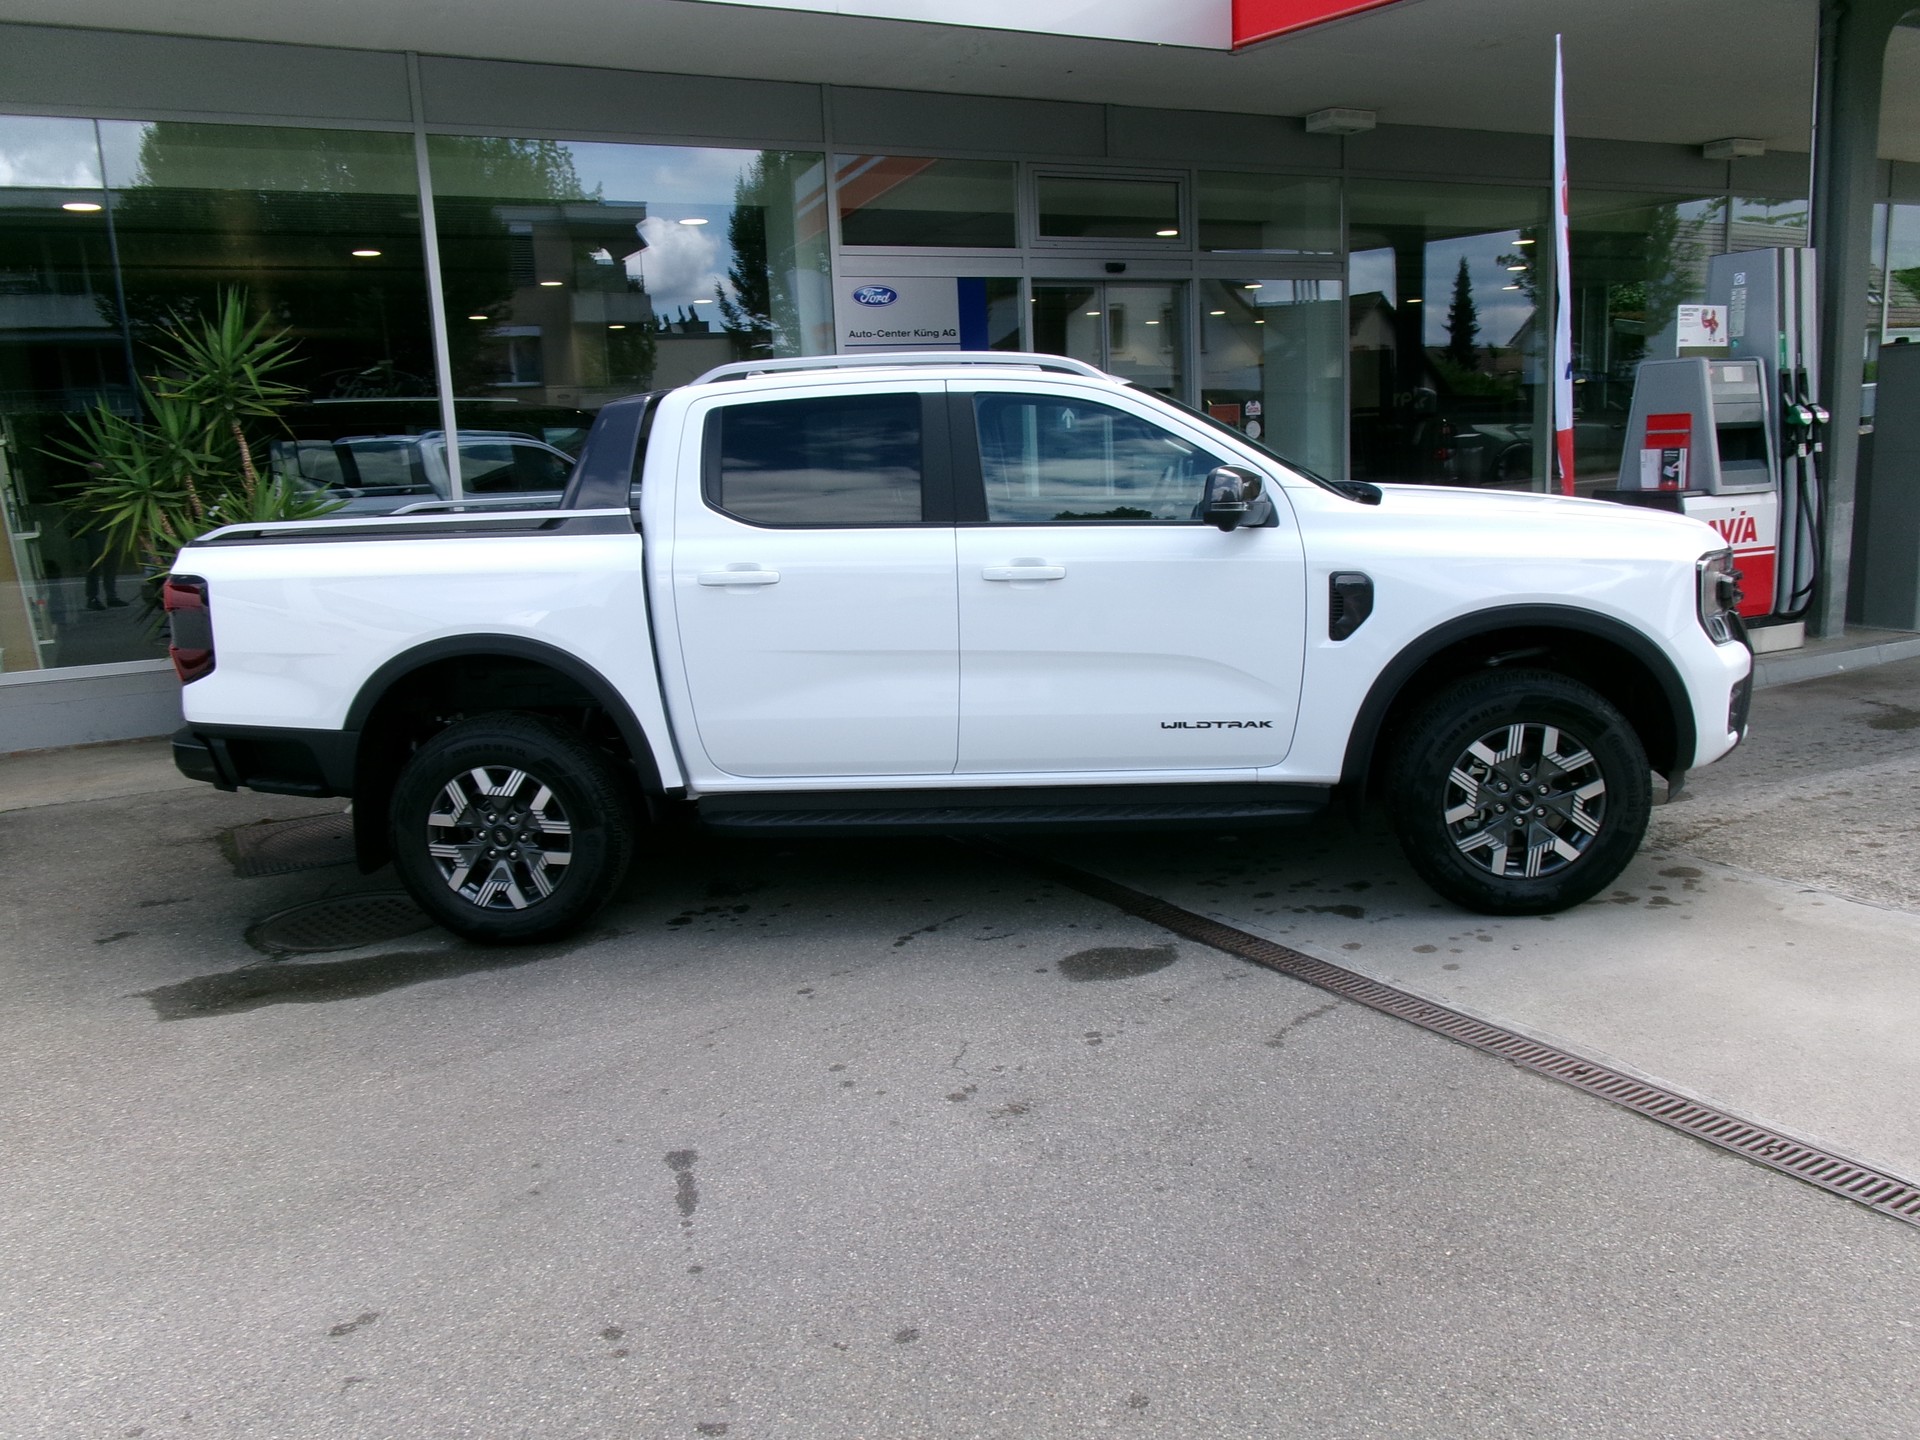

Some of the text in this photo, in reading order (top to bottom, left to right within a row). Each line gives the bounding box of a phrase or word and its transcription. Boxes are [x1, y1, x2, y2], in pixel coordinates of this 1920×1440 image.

[859, 287, 891, 303] Ford
[848, 328, 957, 338] Auto-Center Küng AG
[1160, 720, 1274, 729] WILDTRAK
